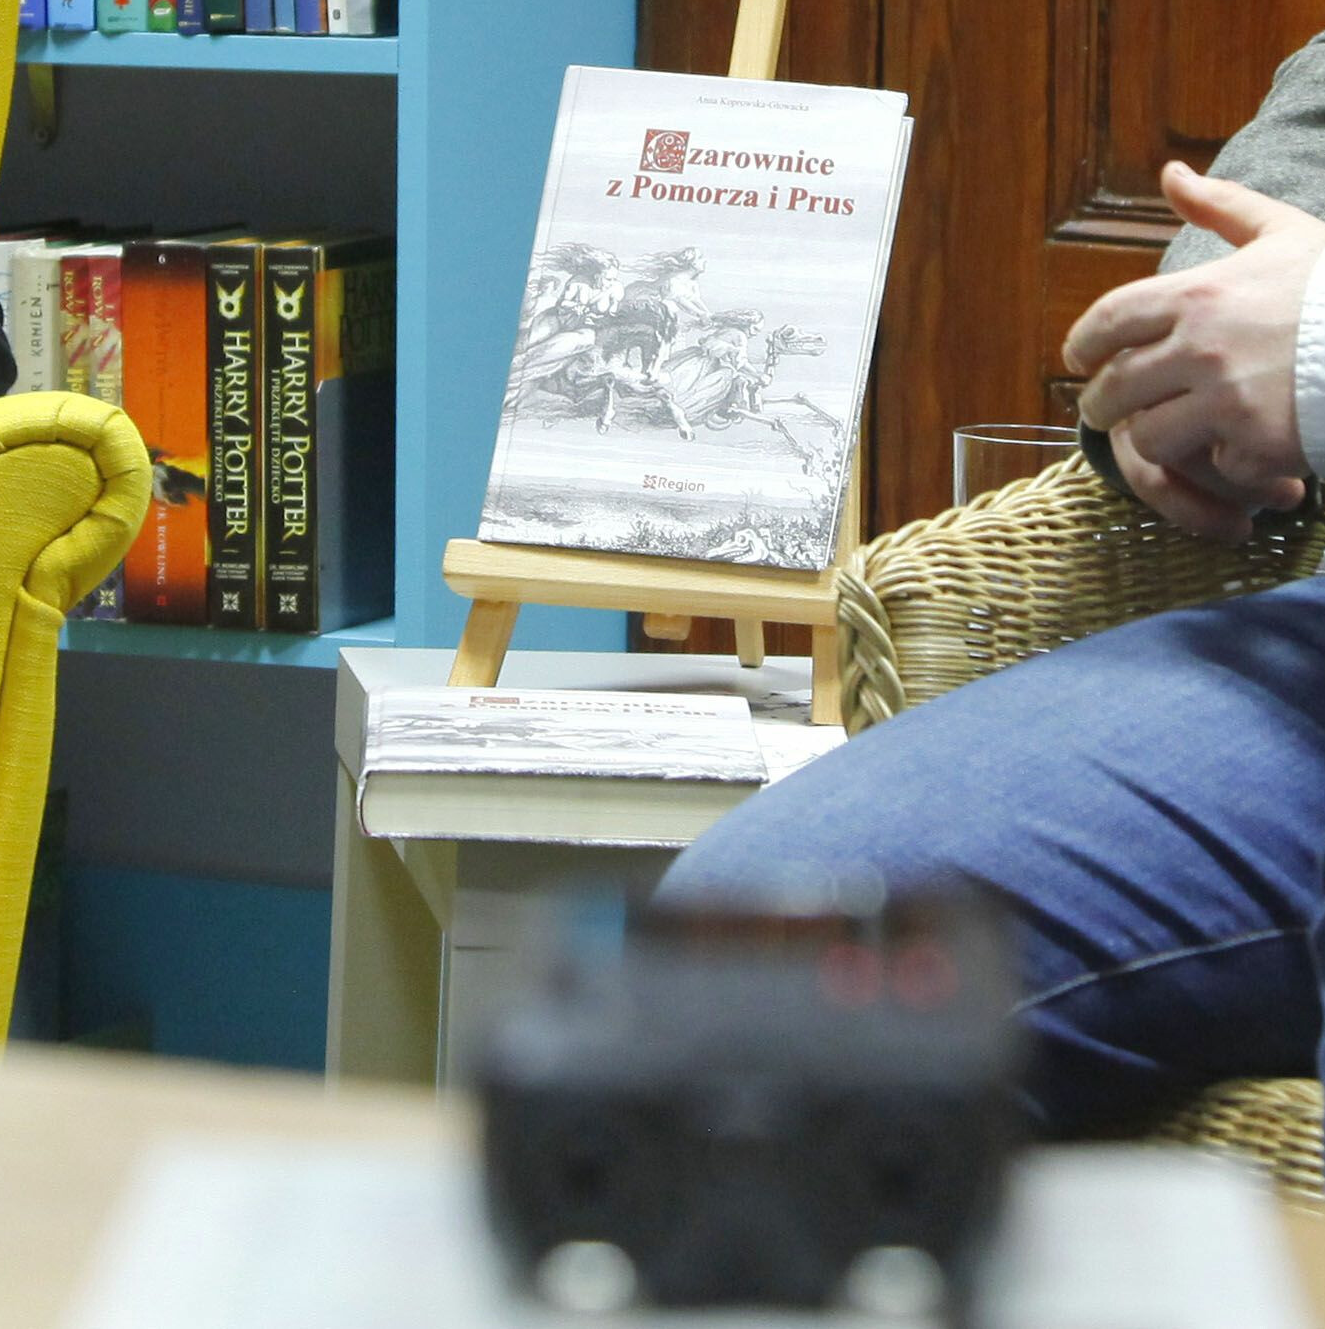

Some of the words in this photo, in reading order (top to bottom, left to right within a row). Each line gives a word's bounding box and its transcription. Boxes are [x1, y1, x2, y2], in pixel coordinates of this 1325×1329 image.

[696, 96, 718, 106] Anna
[639, 128, 835, 176] Czarownice
[606, 179, 622, 199] z
[630, 174, 760, 209] Pomorza
[768, 186, 778, 209] i
[786, 186, 856, 217] Prus
[211, 374, 224, 444] PRZEKLĘTE
[222, 331, 251, 424] HARRY
[280, 331, 310, 427] HARRY
[268, 376, 282, 445] PRZEKLĘTE
[214, 446, 225, 502] DZIECKO
[223, 433, 251, 539] POTTER
[271, 447, 282, 504] DZIECKO
[281, 435, 310, 542] POTTER
[657, 477, 706, 493] Region
